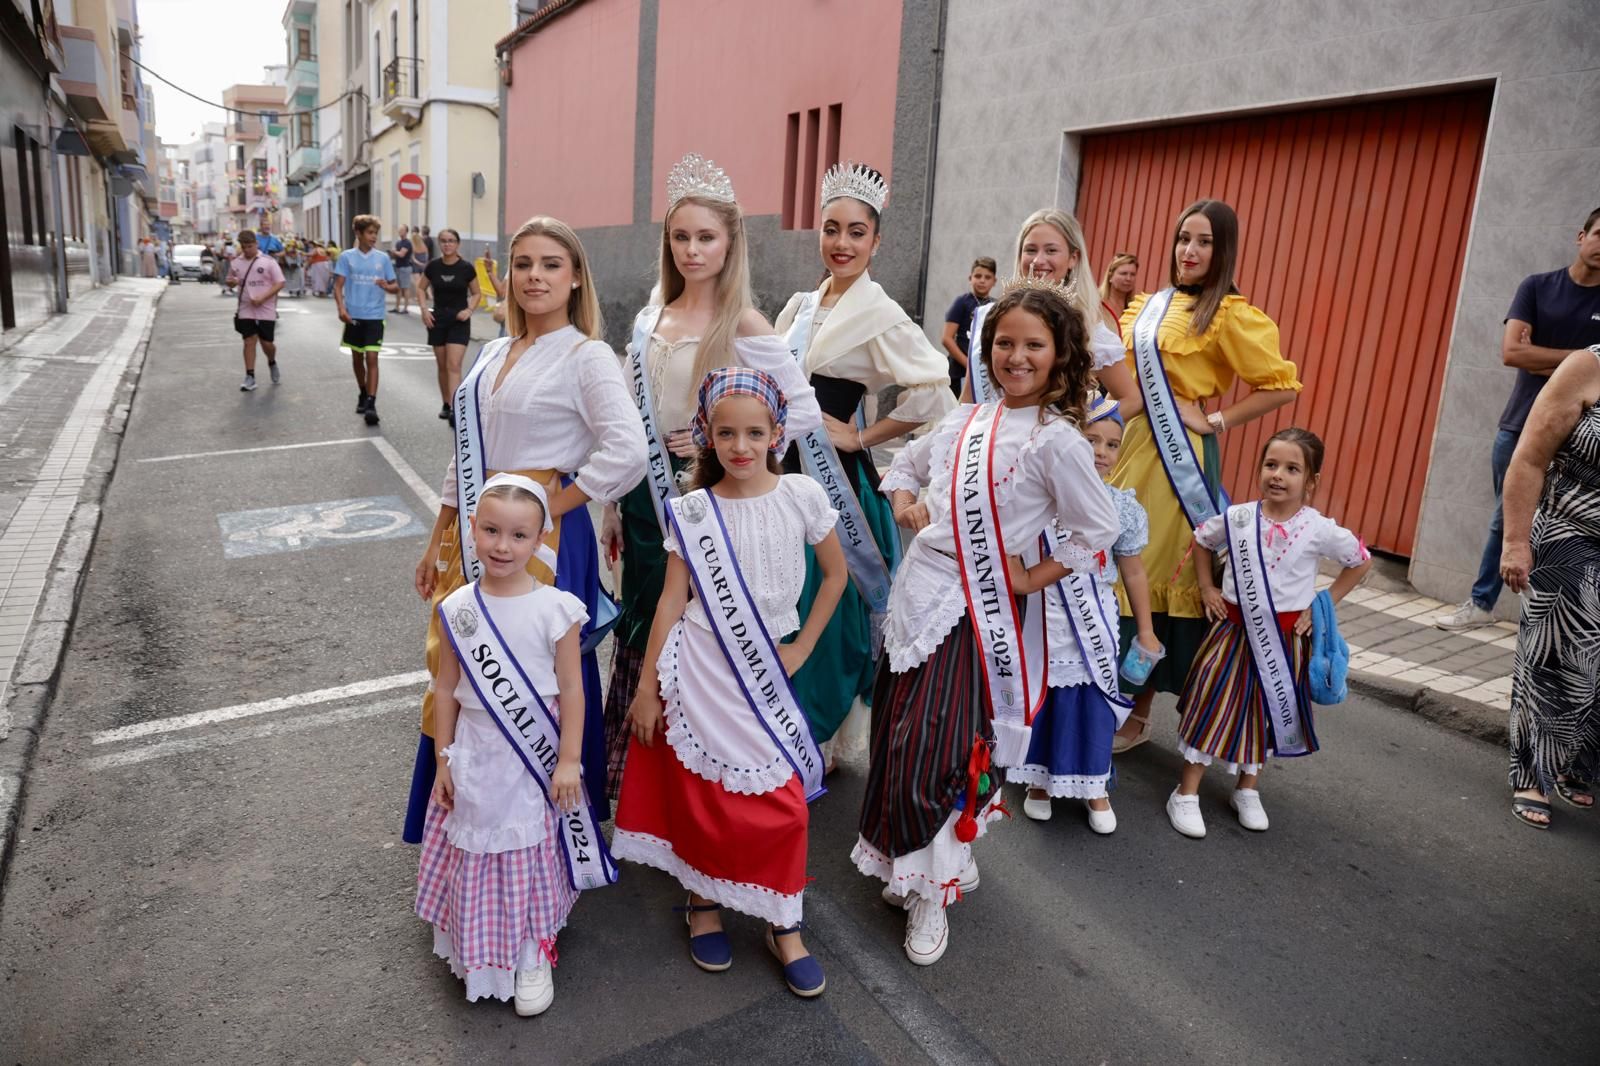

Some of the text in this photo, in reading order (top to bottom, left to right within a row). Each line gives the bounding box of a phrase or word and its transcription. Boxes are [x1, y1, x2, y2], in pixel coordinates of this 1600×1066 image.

[459, 384, 471, 464] TERCERA
[632, 351, 669, 502] MISS ISLETA
[963, 432, 984, 504] REINA
[1151, 392, 1163, 411] DE
[1157, 412, 1183, 463] HONOR
[813, 451, 847, 510] FIESTAS
[841, 513, 863, 547] 2024
[966, 507, 1001, 623] INFANTIL
[699, 535, 814, 774] CUARTA DAMA DE HONOR
[990, 627, 1013, 678] 2024
[1073, 589, 1119, 700] DAMA DE HONO
[1239, 539, 1260, 613] SEGUNDA
[1252, 615, 1272, 658] DAMA
[1267, 659, 1280, 680] DE
[1274, 680, 1293, 728] HONOR
[471, 643, 536, 738] SOCIAL
